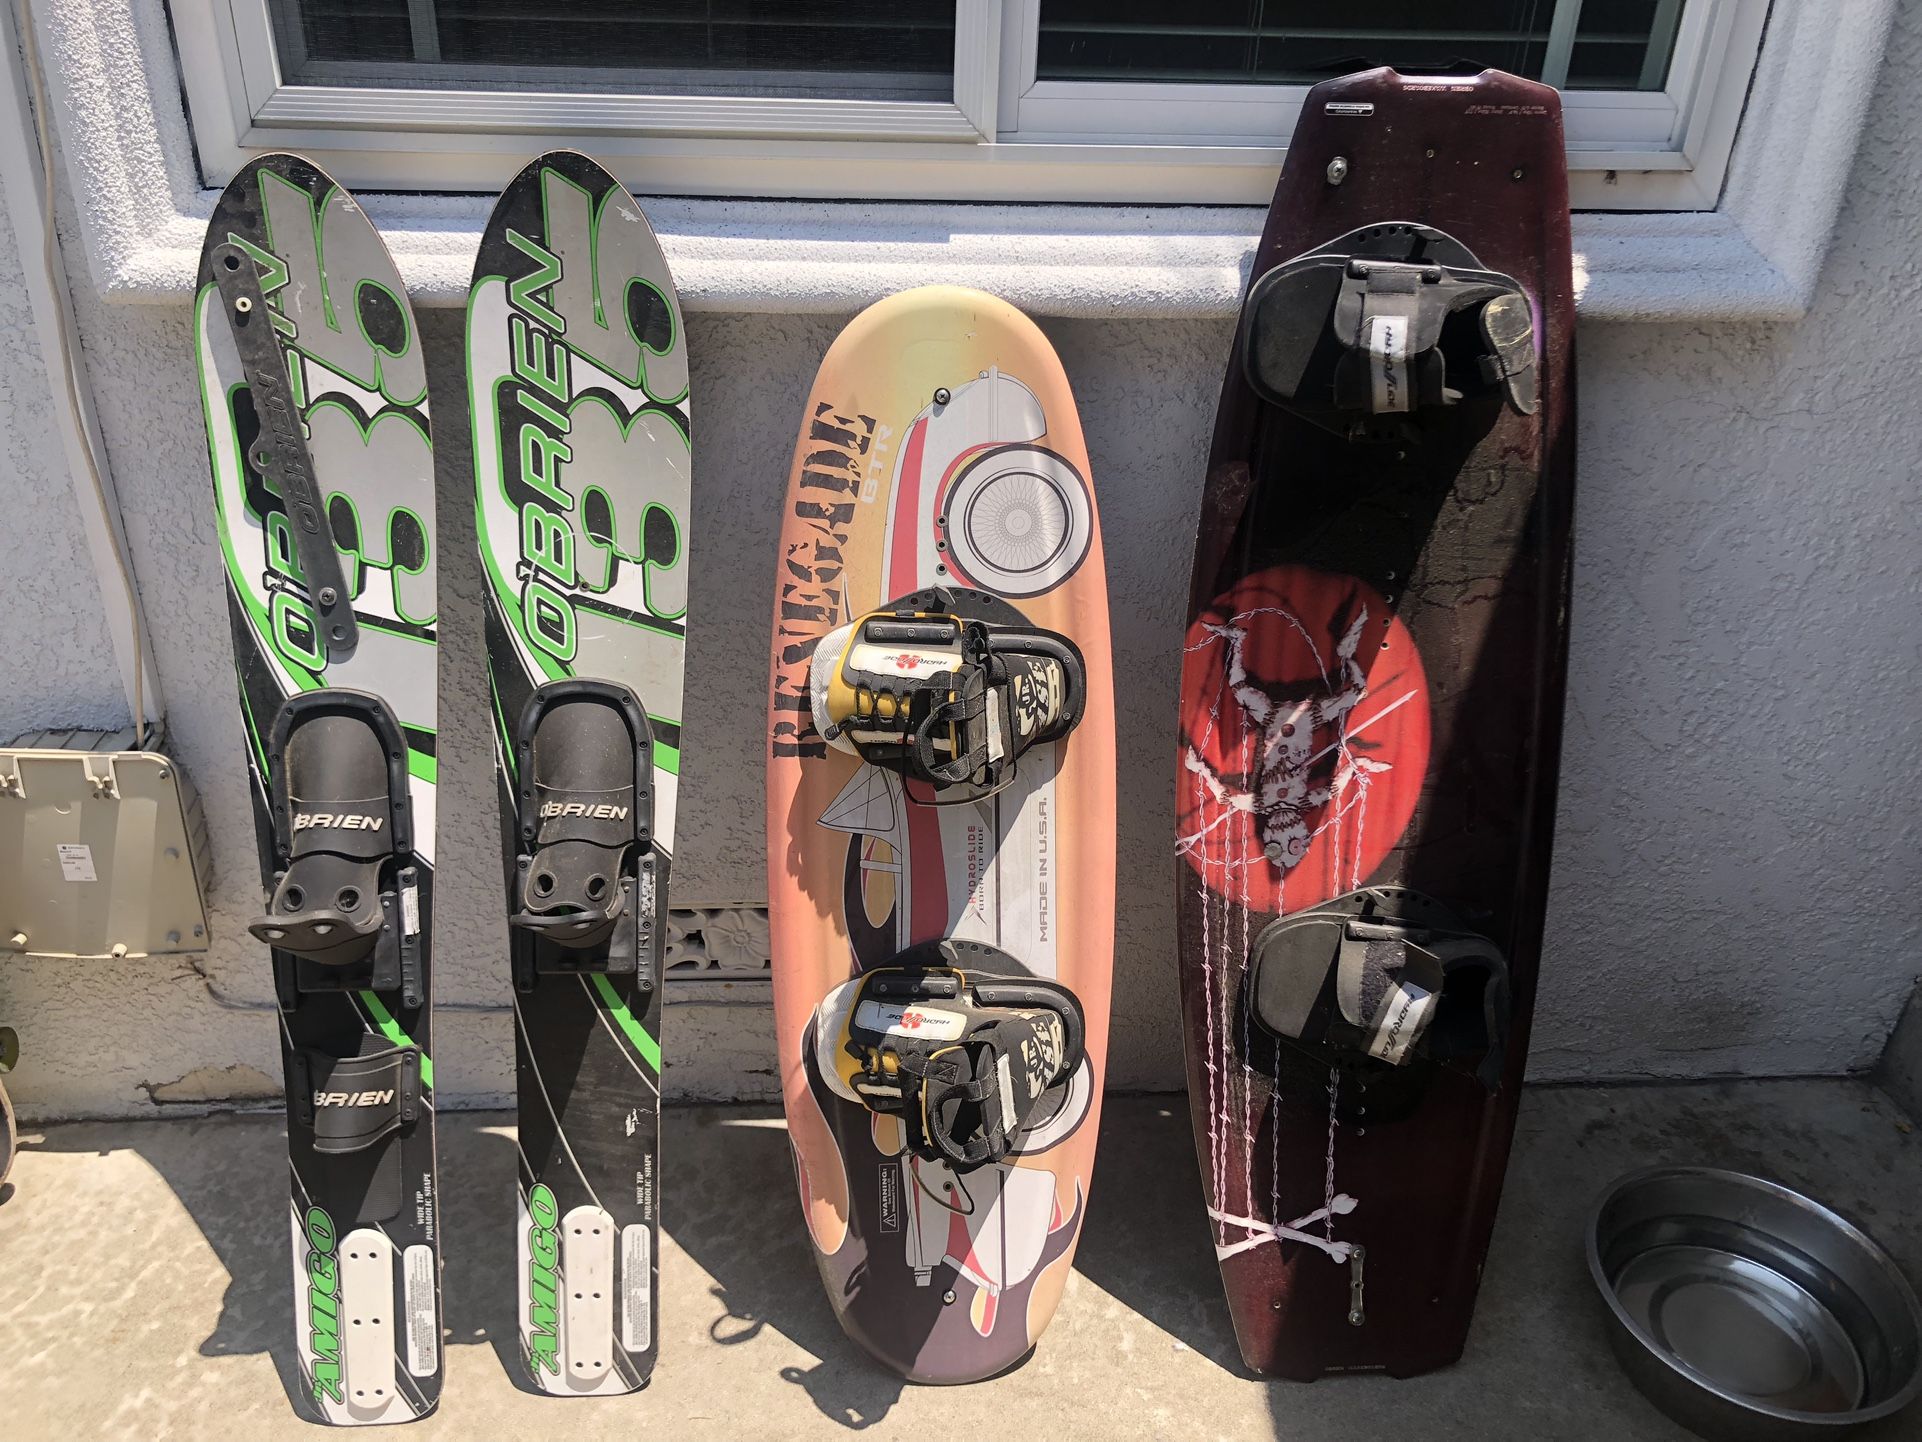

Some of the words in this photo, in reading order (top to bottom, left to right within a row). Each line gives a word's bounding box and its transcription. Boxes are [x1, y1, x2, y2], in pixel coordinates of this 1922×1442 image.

[505, 226, 582, 670] O'BRIEN
[772, 402, 877, 760] RENEGADE
[1038, 797, 1048, 854] U.S.A.
[968, 825, 976, 904] HYDROSLIDE
[1039, 858, 1048, 877] IN
[1039, 881, 1048, 942] MADE
[423, 1172, 432, 1197] SHAPE
[636, 1171, 644, 1184] TIP
[644, 1153, 652, 1178] SHAPE
[416, 1190, 424, 1203] TIP
[416, 1205, 425, 1225] WIDE
[636, 1185, 644, 1205] WIDE
[644, 1178, 652, 1220] PARABOLIC
[424, 1198, 434, 1241] PARABOLIC
[530, 1182, 561, 1376] AMIGO
[305, 1205, 345, 1404] AMIGO
